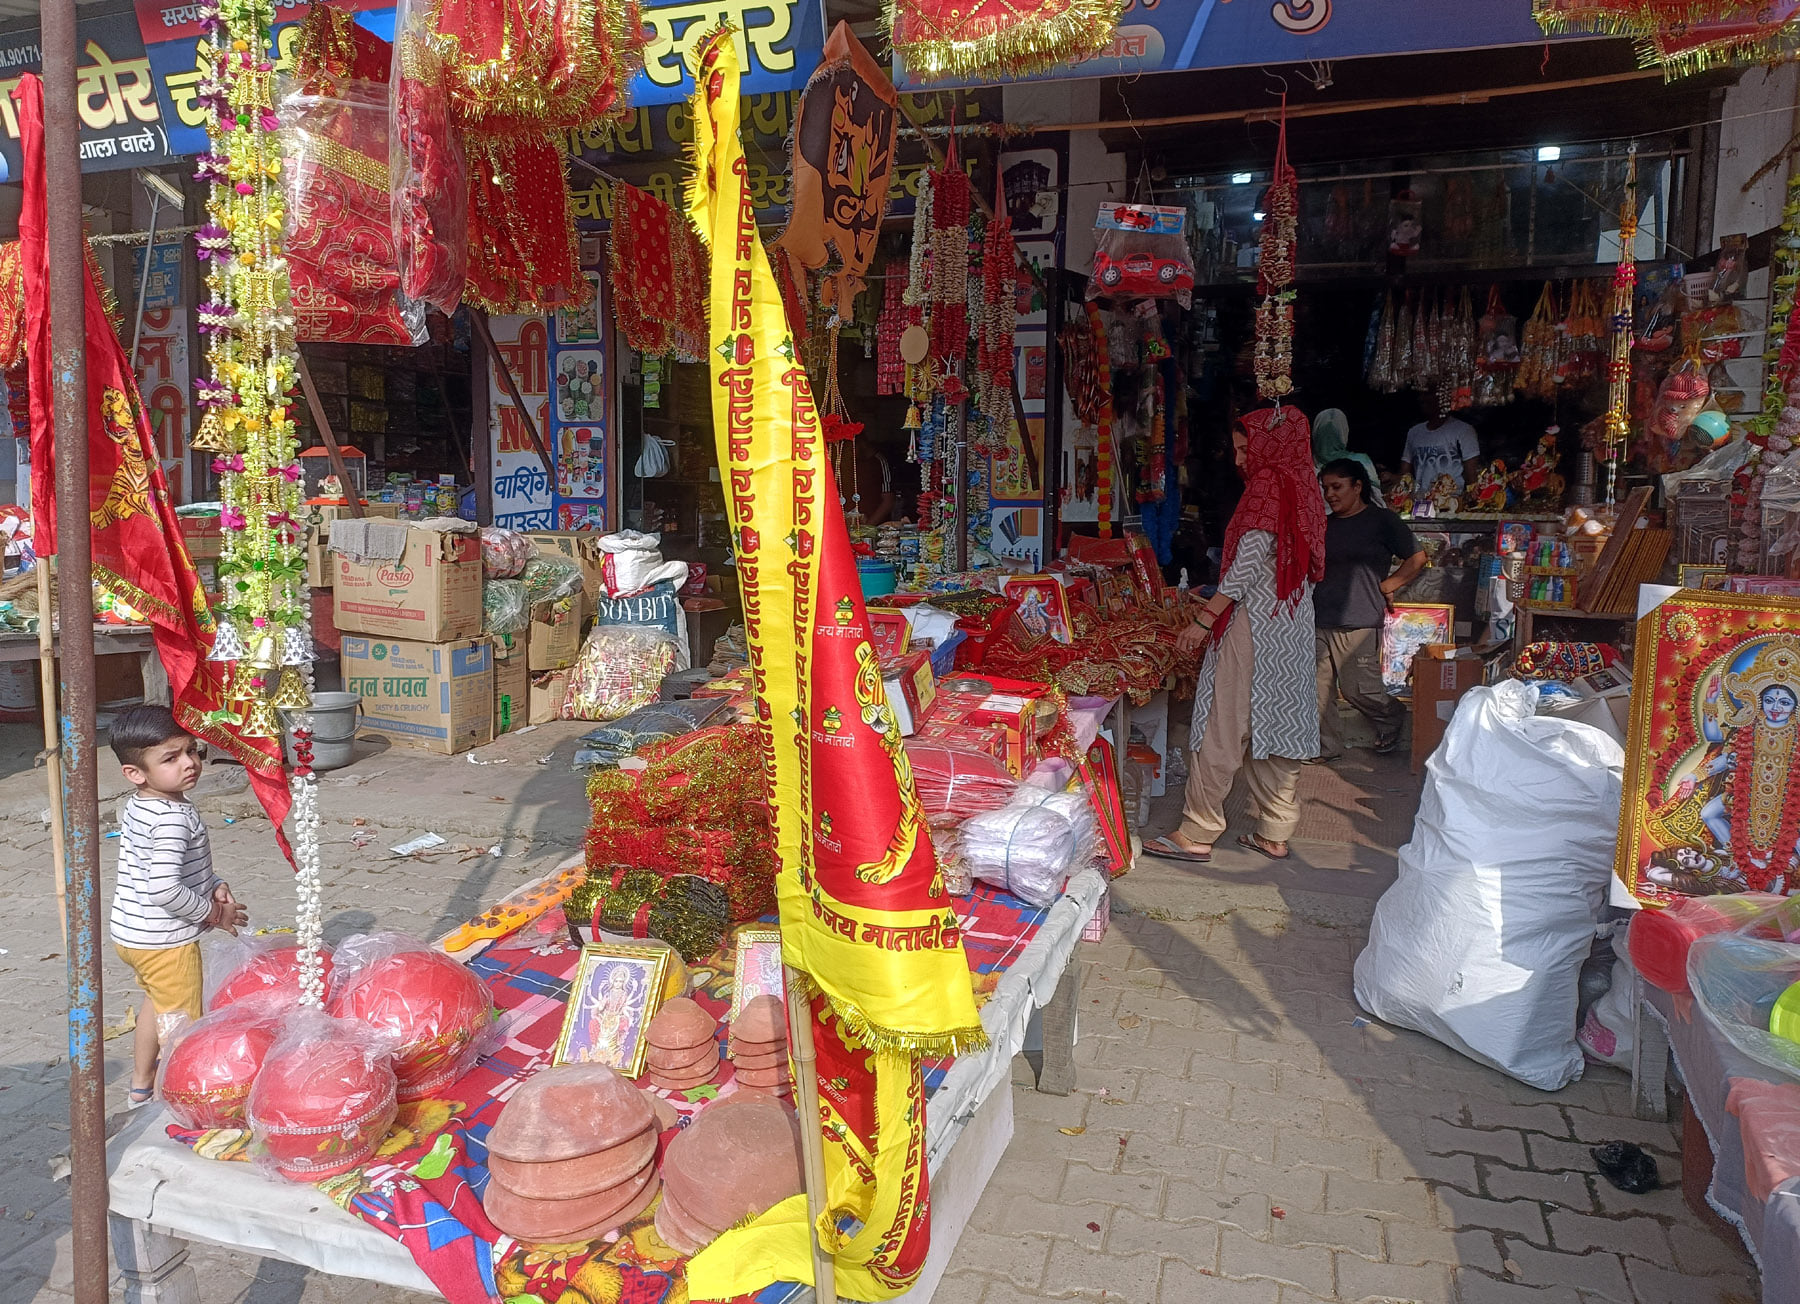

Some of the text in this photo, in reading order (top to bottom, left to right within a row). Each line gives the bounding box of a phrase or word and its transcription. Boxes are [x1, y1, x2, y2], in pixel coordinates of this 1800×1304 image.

[731, 268, 753, 332] जय
[719, 367, 755, 524] जय मातादी
[782, 367, 816, 526] जय मातादी
[380, 569, 411, 582] Pasta
[738, 555, 767, 694] जय मातादी
[787, 560, 810, 702] जय मातादी
[816, 625, 834, 639] जय
[383, 676, 429, 697] चावल
[822, 903, 940, 952] जय मातादी
